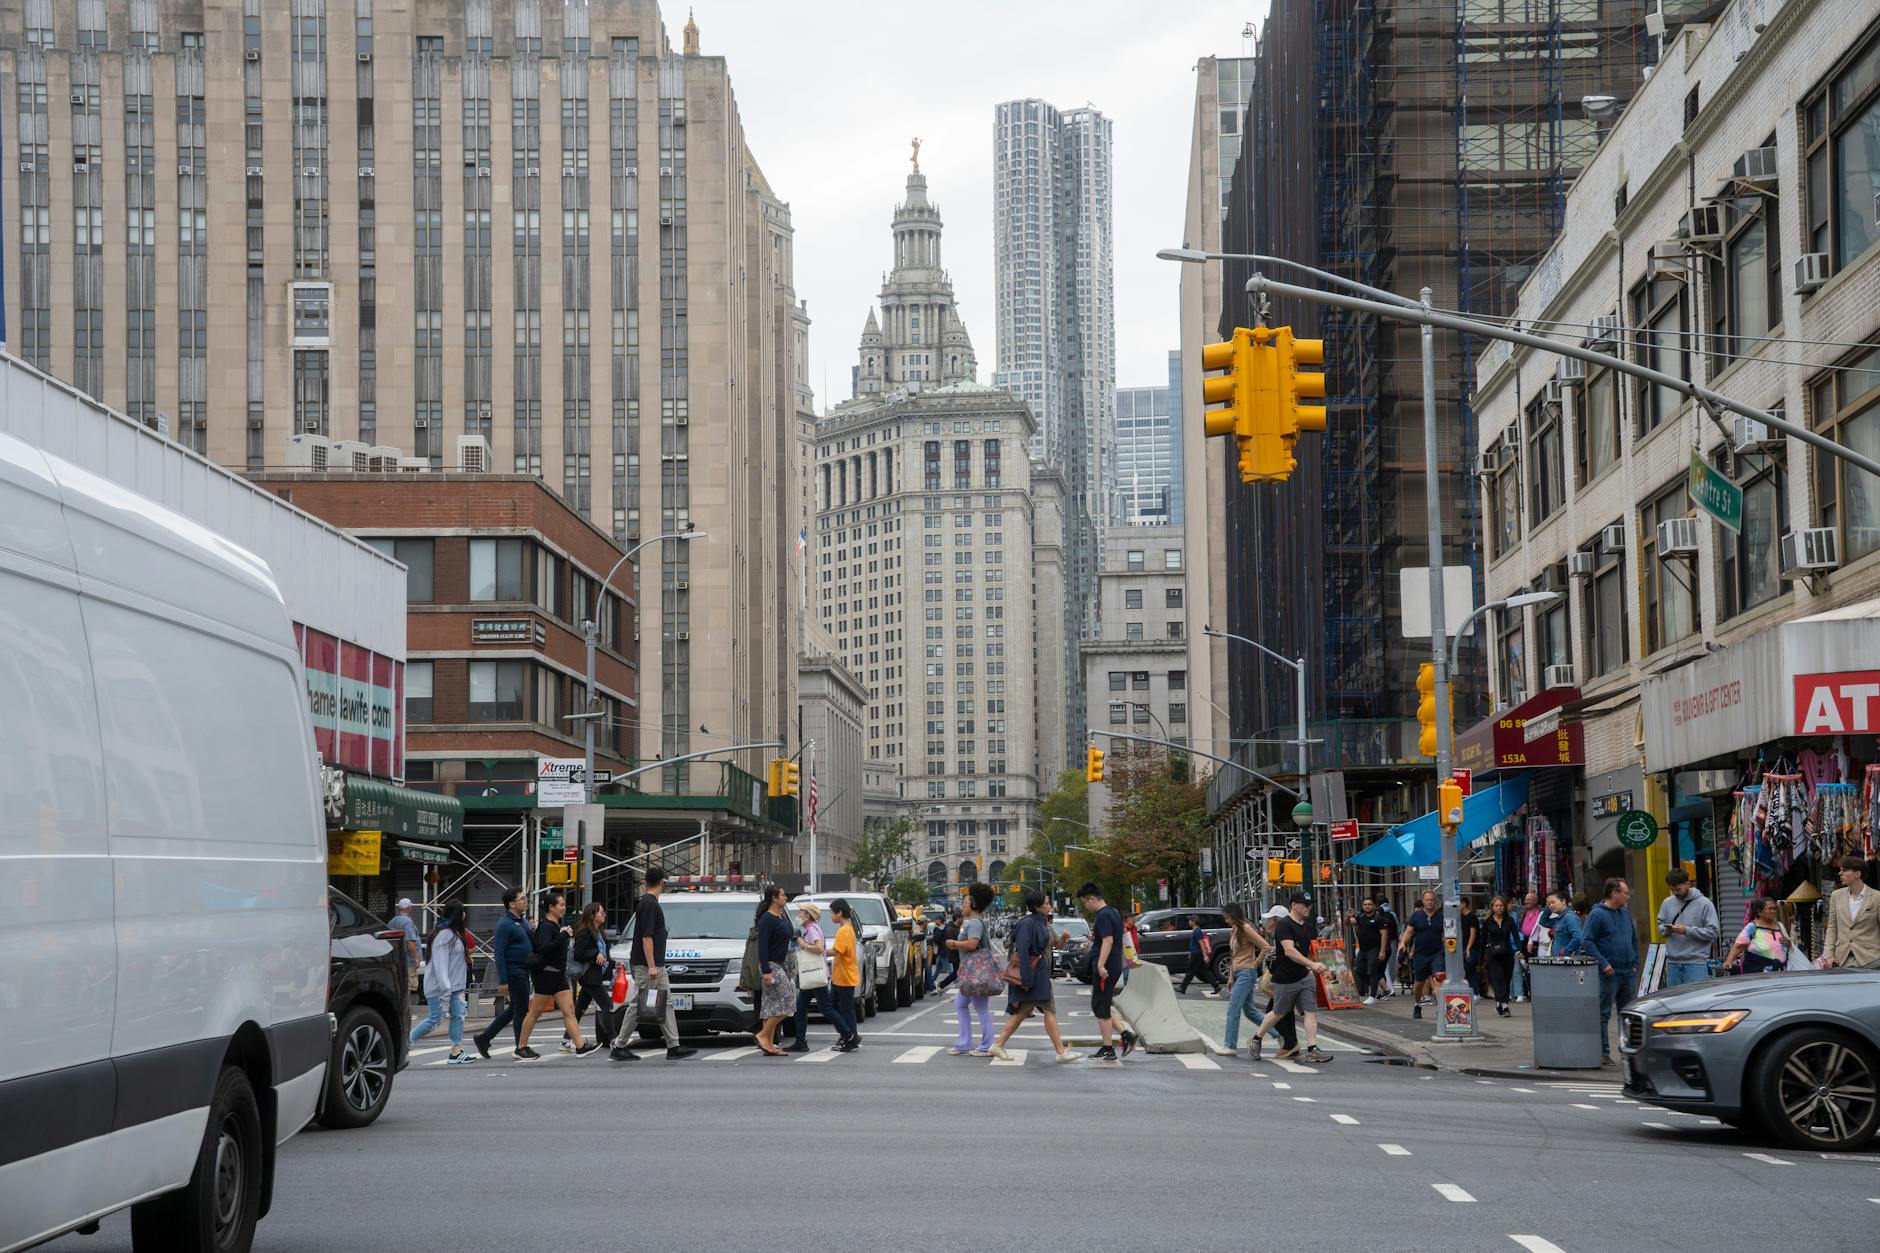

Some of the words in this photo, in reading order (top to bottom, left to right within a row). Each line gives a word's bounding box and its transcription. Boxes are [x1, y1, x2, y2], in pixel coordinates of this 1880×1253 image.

[1722, 489, 1731, 515] St
[1682, 693, 1704, 722] SOUVENIR
[1709, 687, 1720, 713] GIFT
[1720, 680, 1741, 710] CENTER
[1500, 720, 1513, 729] DG
[1502, 754, 1526, 763] 153A
[540, 761, 583, 776] Xtreme
[551, 829, 563, 837] Wal
